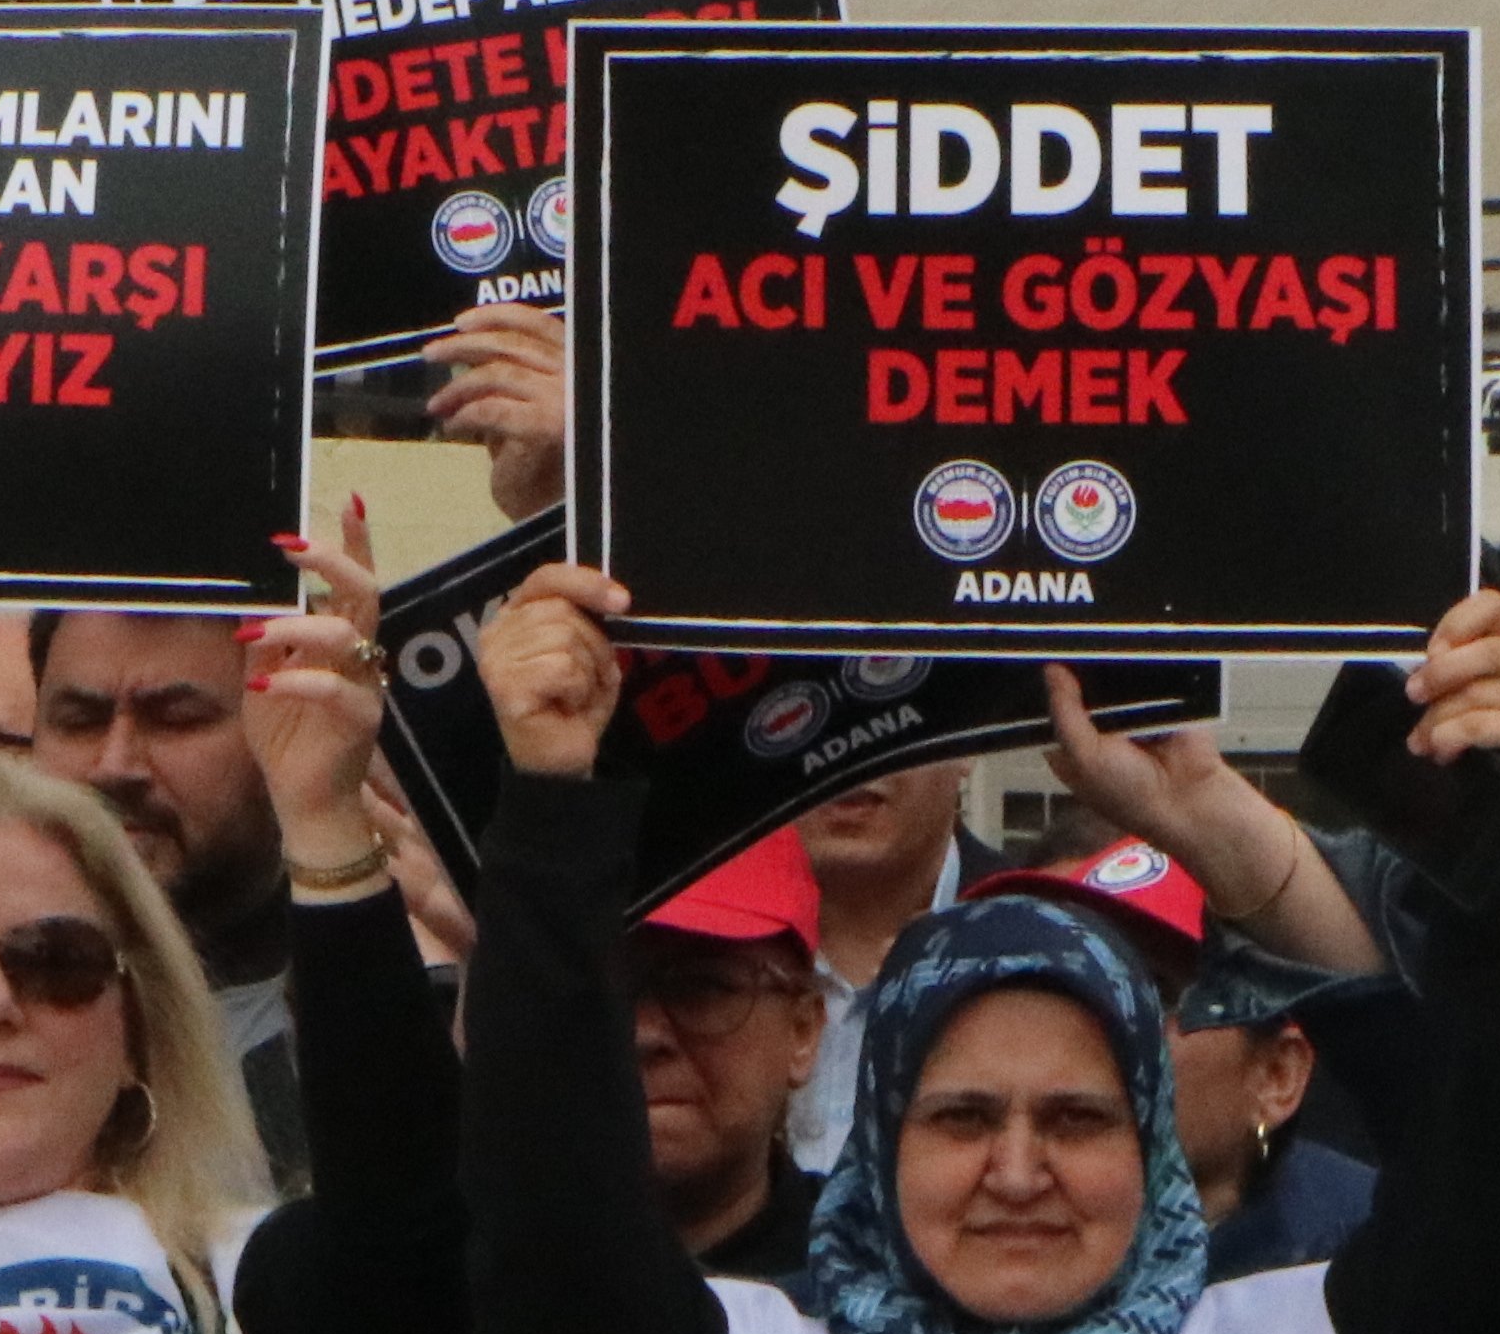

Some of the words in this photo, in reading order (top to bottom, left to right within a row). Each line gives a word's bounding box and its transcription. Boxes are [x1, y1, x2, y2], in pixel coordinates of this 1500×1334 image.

[327, 33, 531, 123] DETE
[322, 103, 567, 202] AYAKT
[774, 100, 1274, 238] ŞİDDET
[476, 268, 566, 306] ADAN
[671, 253, 827, 330] ACI
[853, 253, 977, 329] VE
[1002, 237, 1396, 346] GÖZYAŞI
[865, 349, 1188, 425] DEMEK
[953, 570, 1095, 605] ADANA
[802, 703, 925, 778] ADANA
